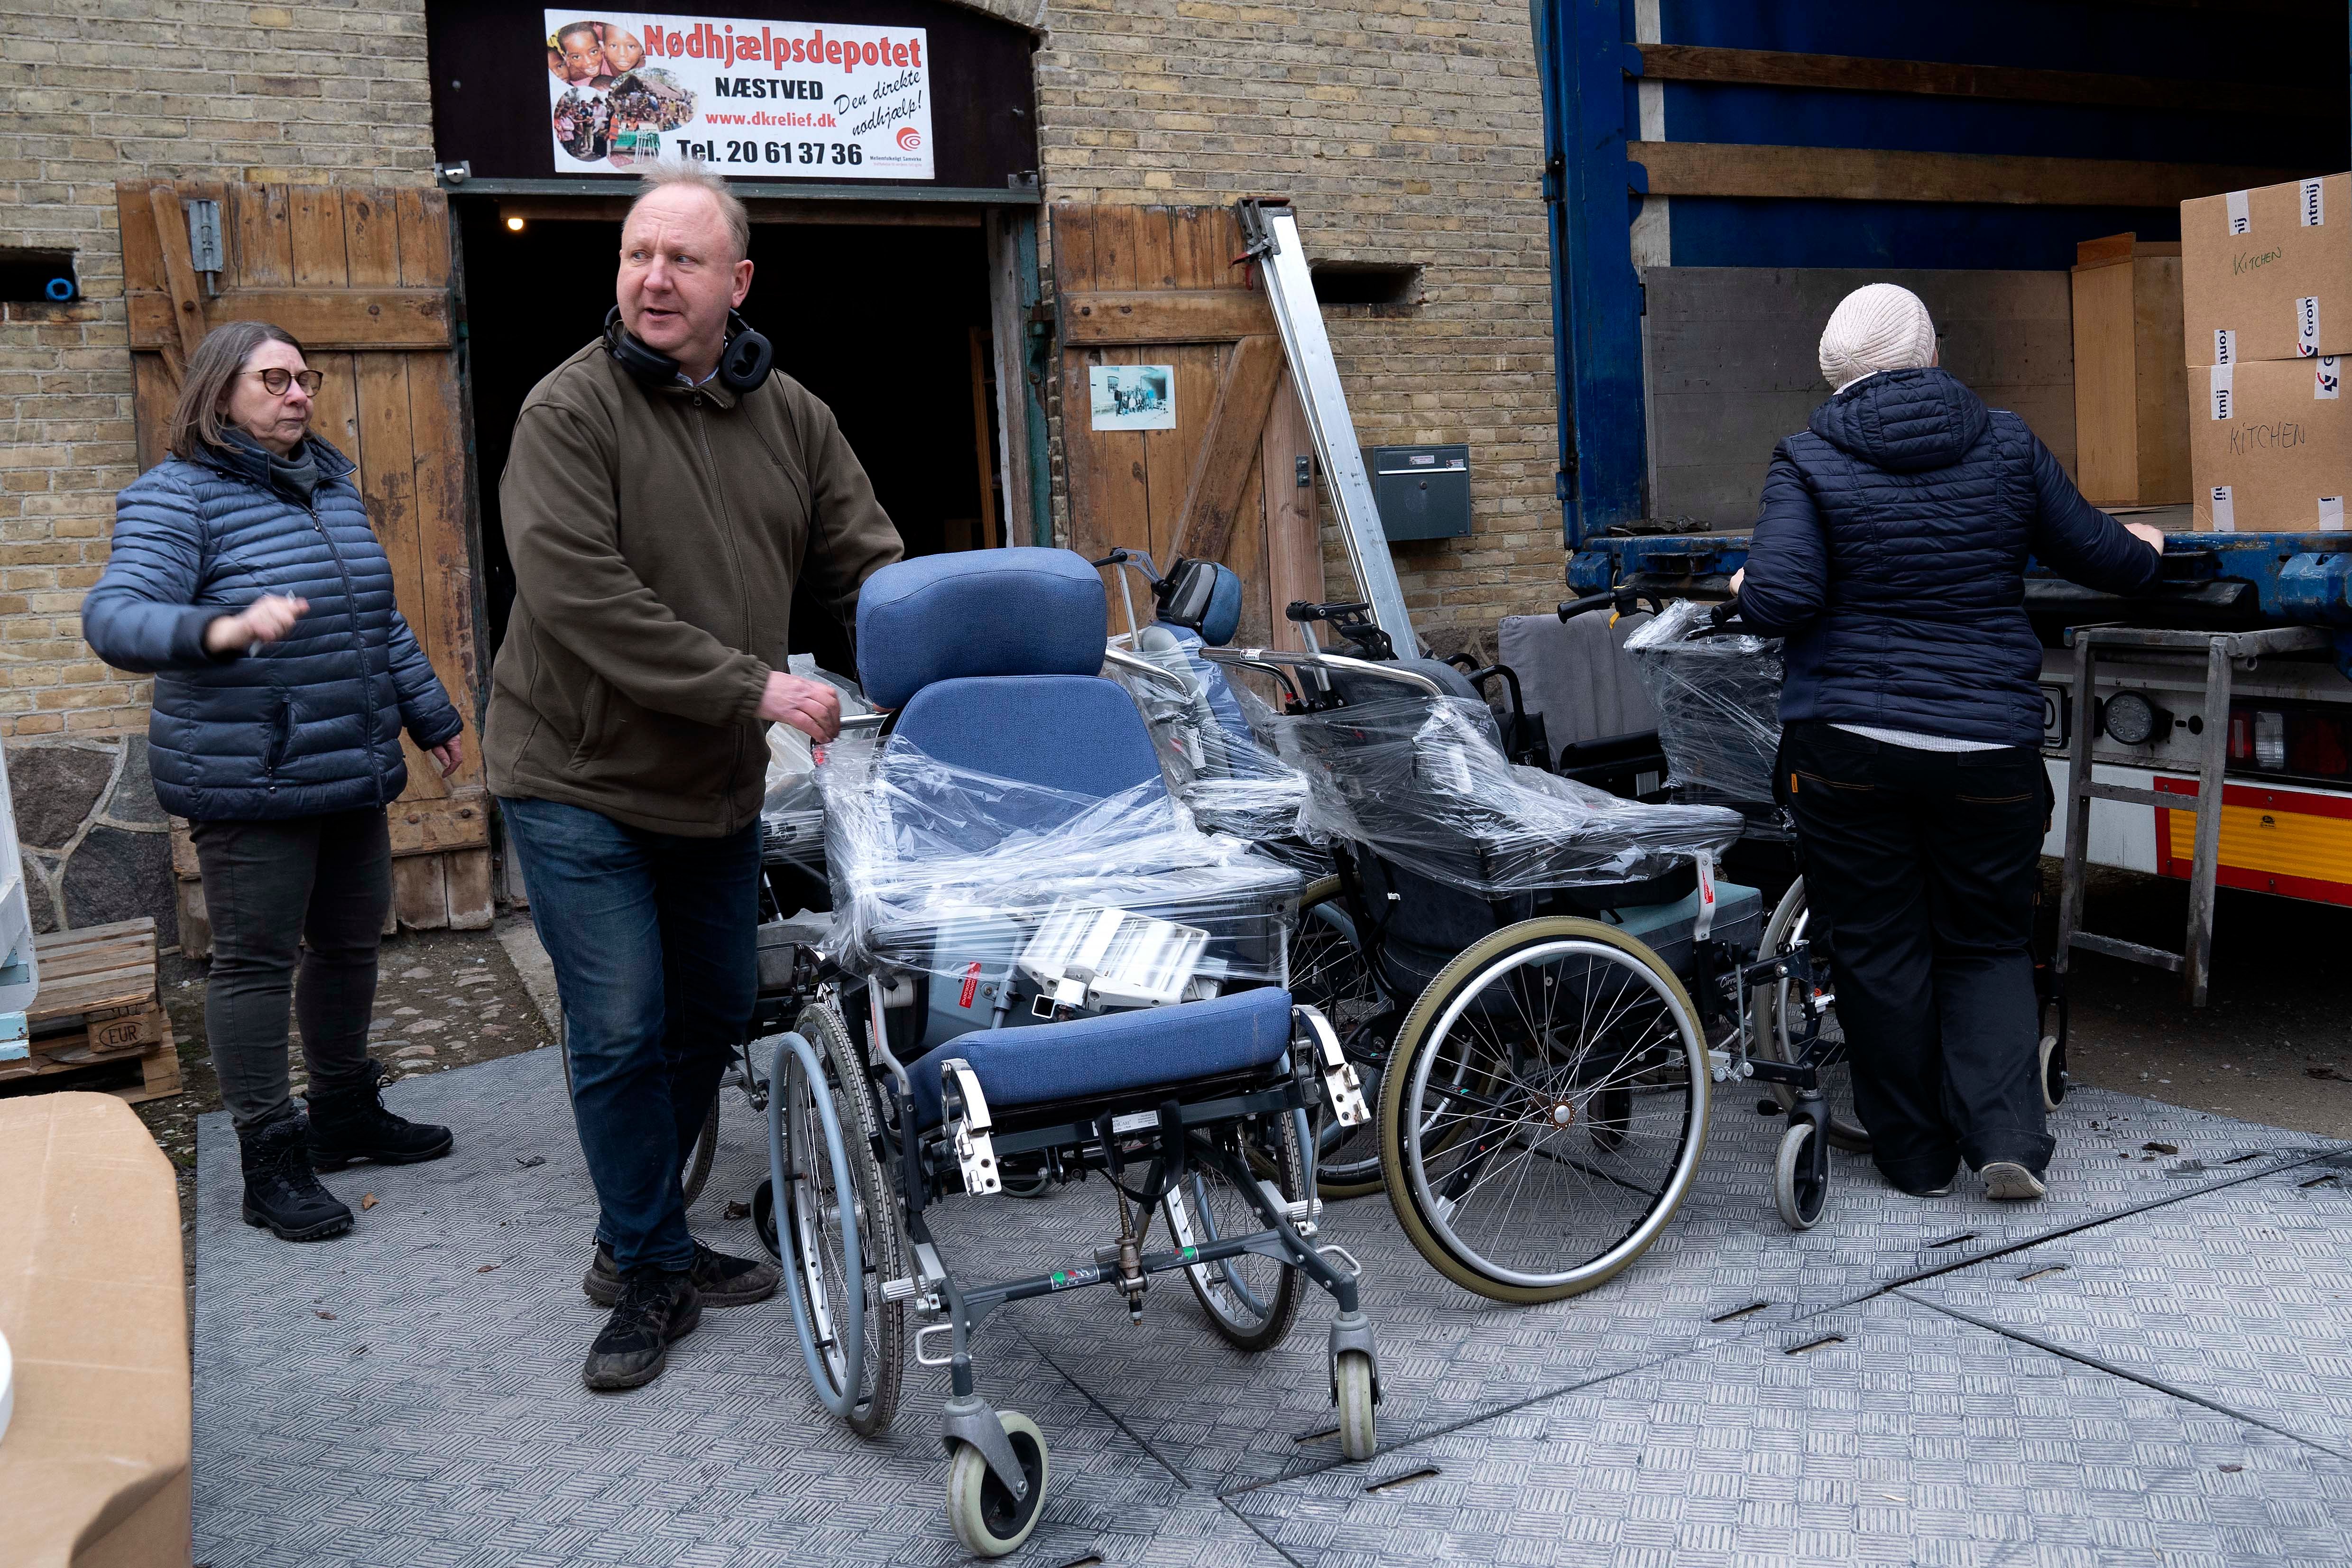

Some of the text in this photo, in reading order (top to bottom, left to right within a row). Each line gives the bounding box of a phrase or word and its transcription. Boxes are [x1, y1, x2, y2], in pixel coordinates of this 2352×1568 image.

[644, 23, 922, 74] Nødhjælpsdepotet
[715, 77, 824, 100] NÆSTVED
[833, 69, 921, 115] Den direkte
[705, 111, 837, 128] www.dkrelief.dk
[852, 90, 922, 136] nødhjælp!
[676, 139, 863, 166] Tel. 20 61 37 36
[2304, 297, 2315, 337] Gron
[2219, 330, 2228, 364] ront
[108, 1025, 138, 1044] EUR
